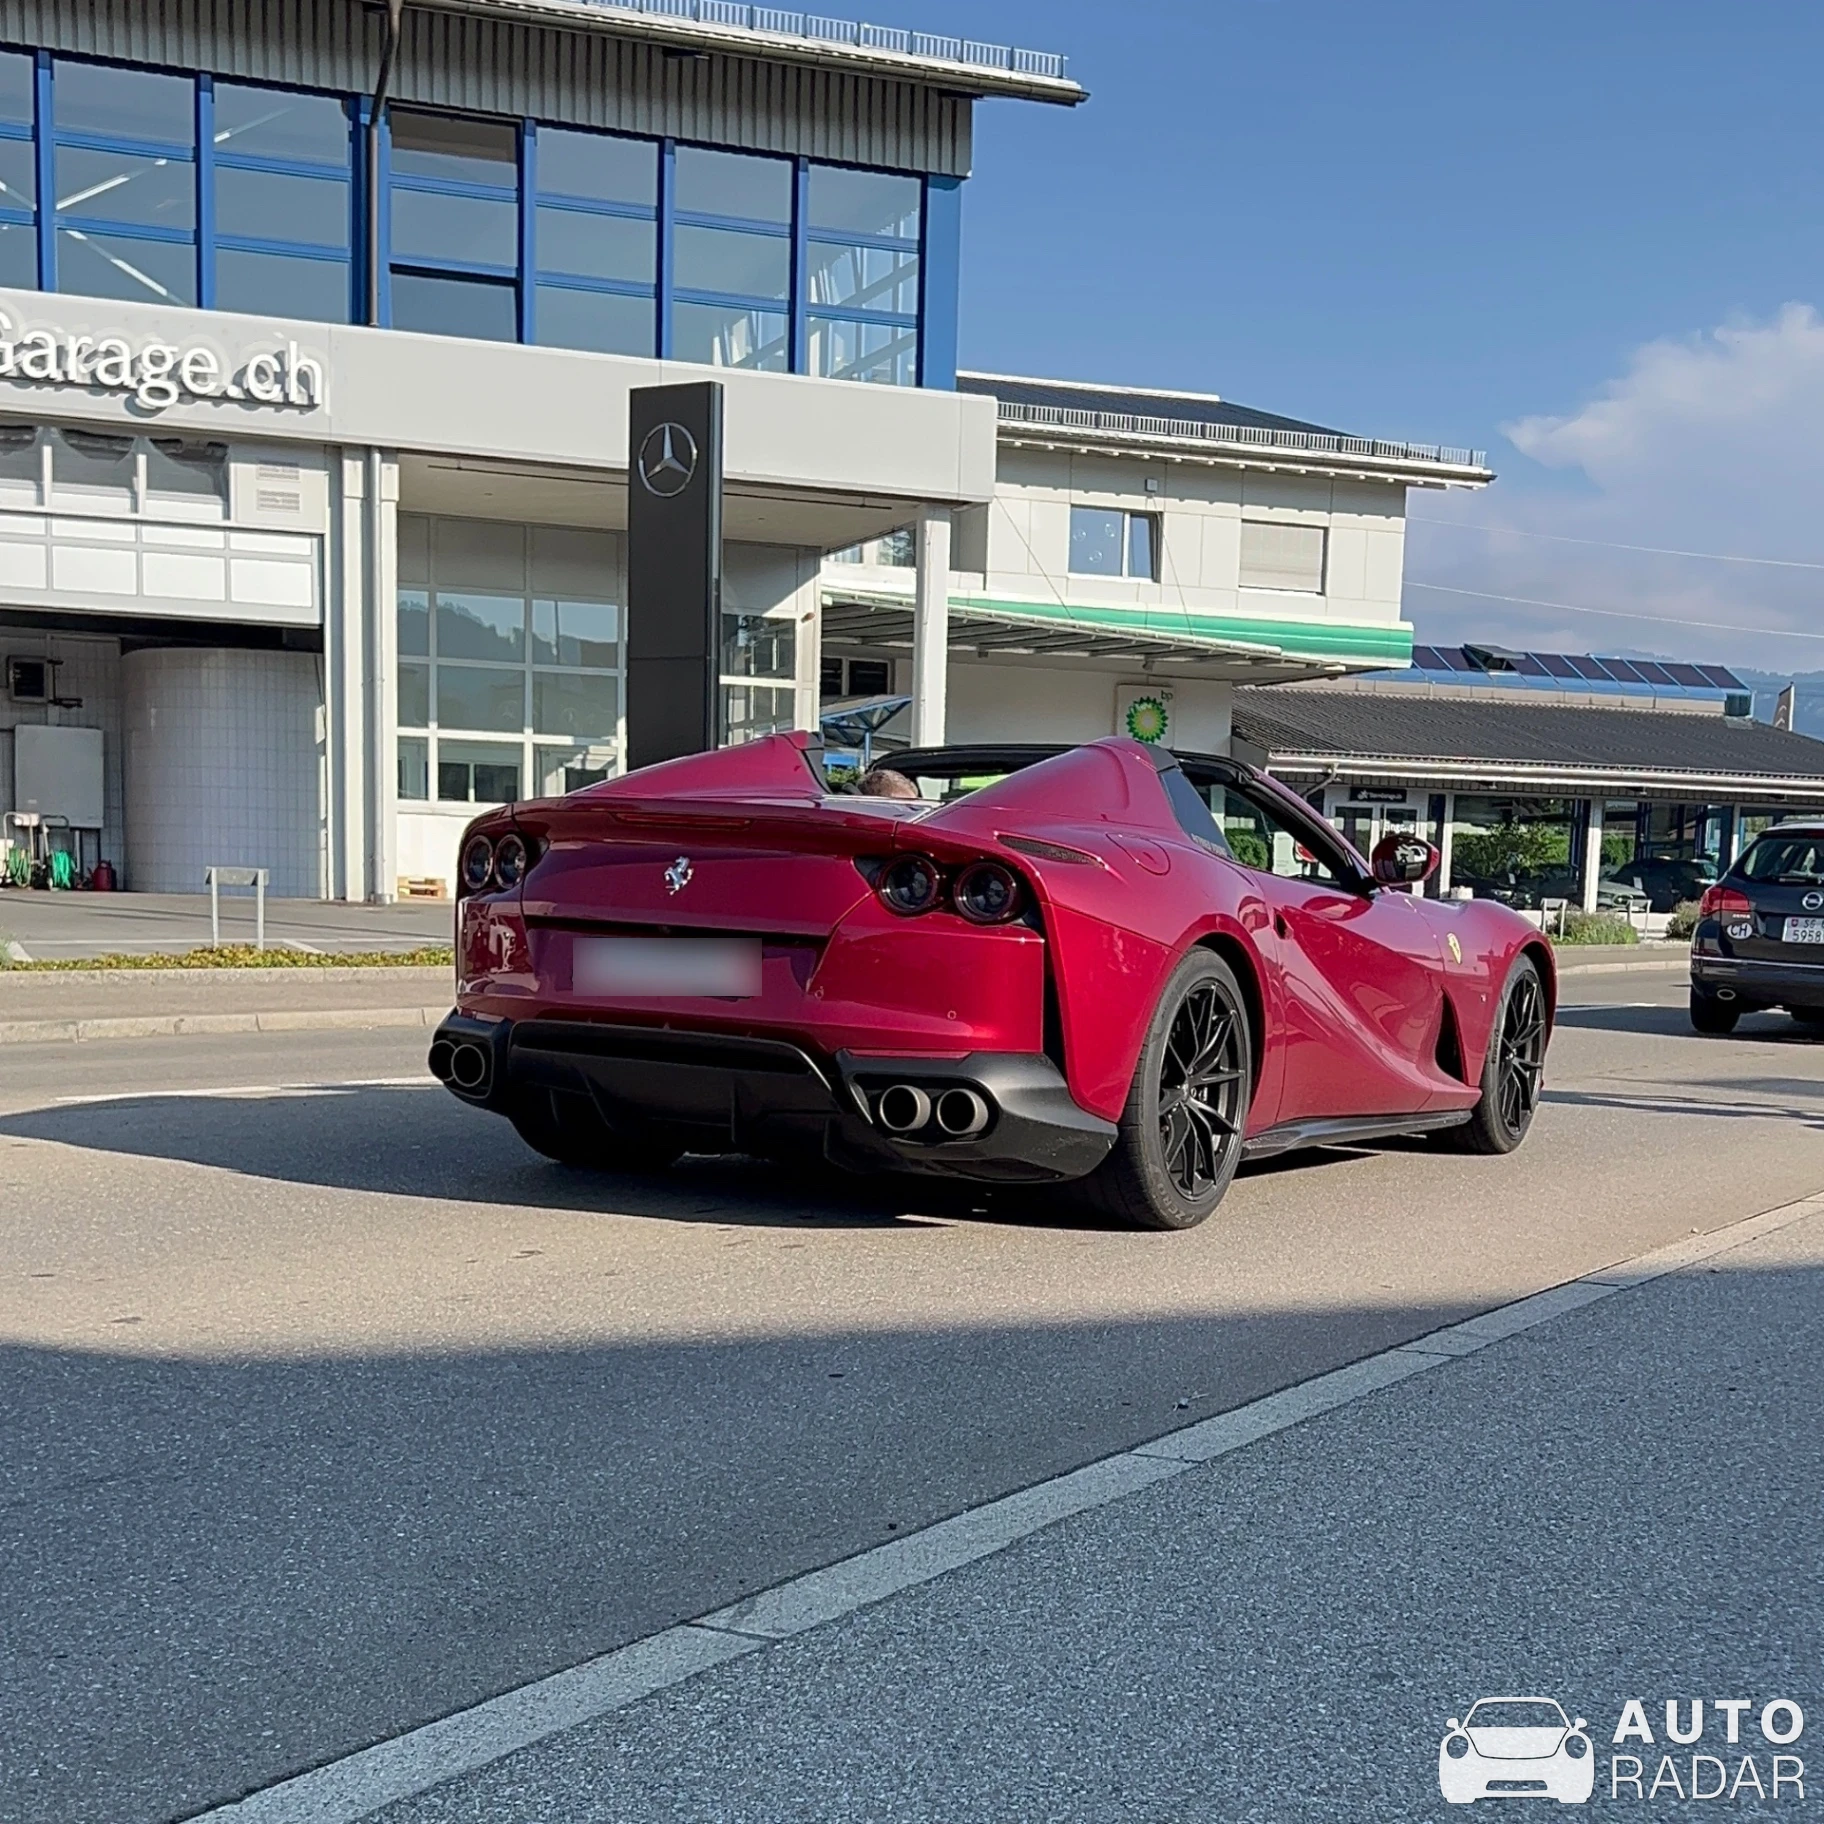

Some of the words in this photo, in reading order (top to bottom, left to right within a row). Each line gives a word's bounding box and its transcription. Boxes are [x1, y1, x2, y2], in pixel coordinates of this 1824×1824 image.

[1161, 690, 1173, 702] bp
[1803, 918, 1817, 929] SG
[1731, 923, 1748, 937] CH
